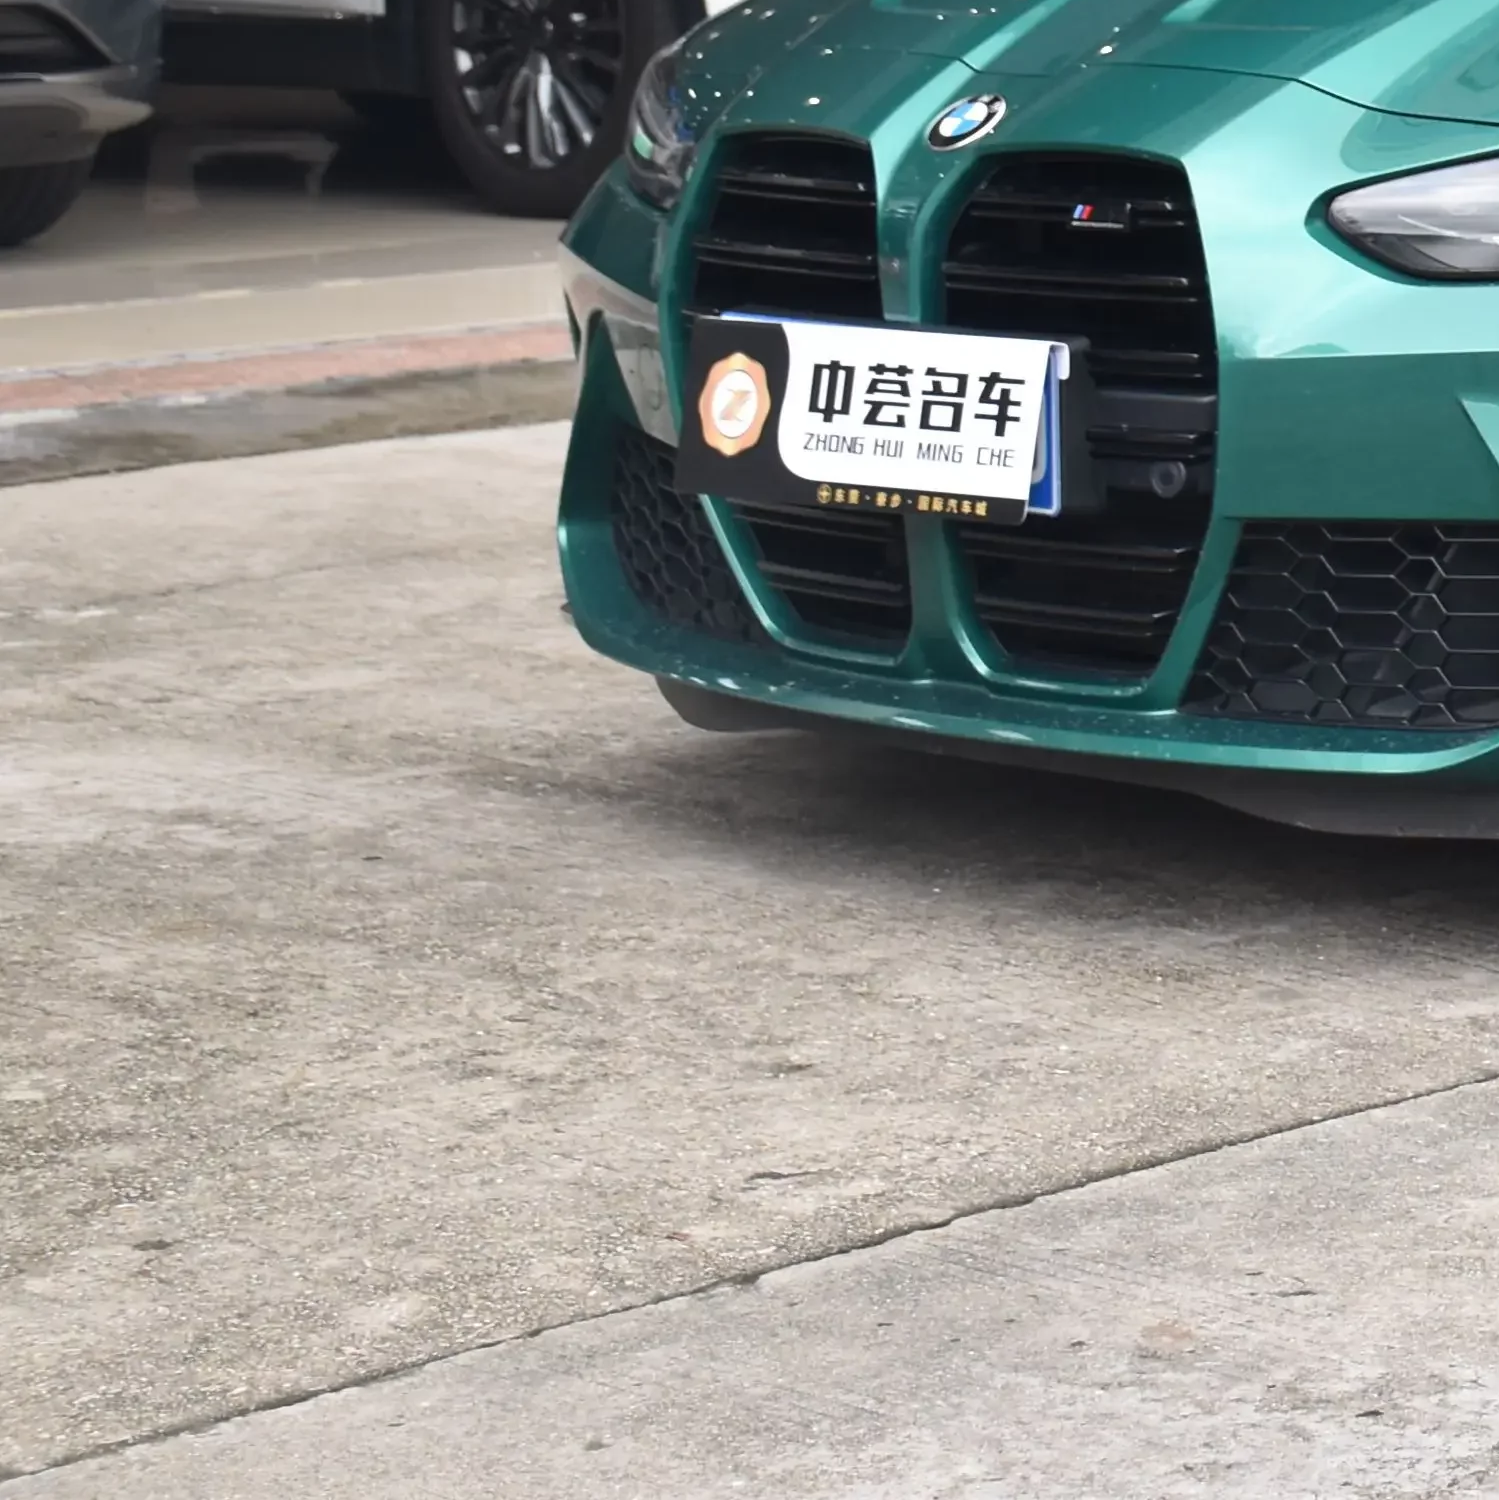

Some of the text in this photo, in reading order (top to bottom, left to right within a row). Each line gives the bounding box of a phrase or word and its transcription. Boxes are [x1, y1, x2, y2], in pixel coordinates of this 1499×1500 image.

[808, 359, 1026, 437] 中荟名车
[803, 432, 1015, 468] ZHONG HUI MING CHE
